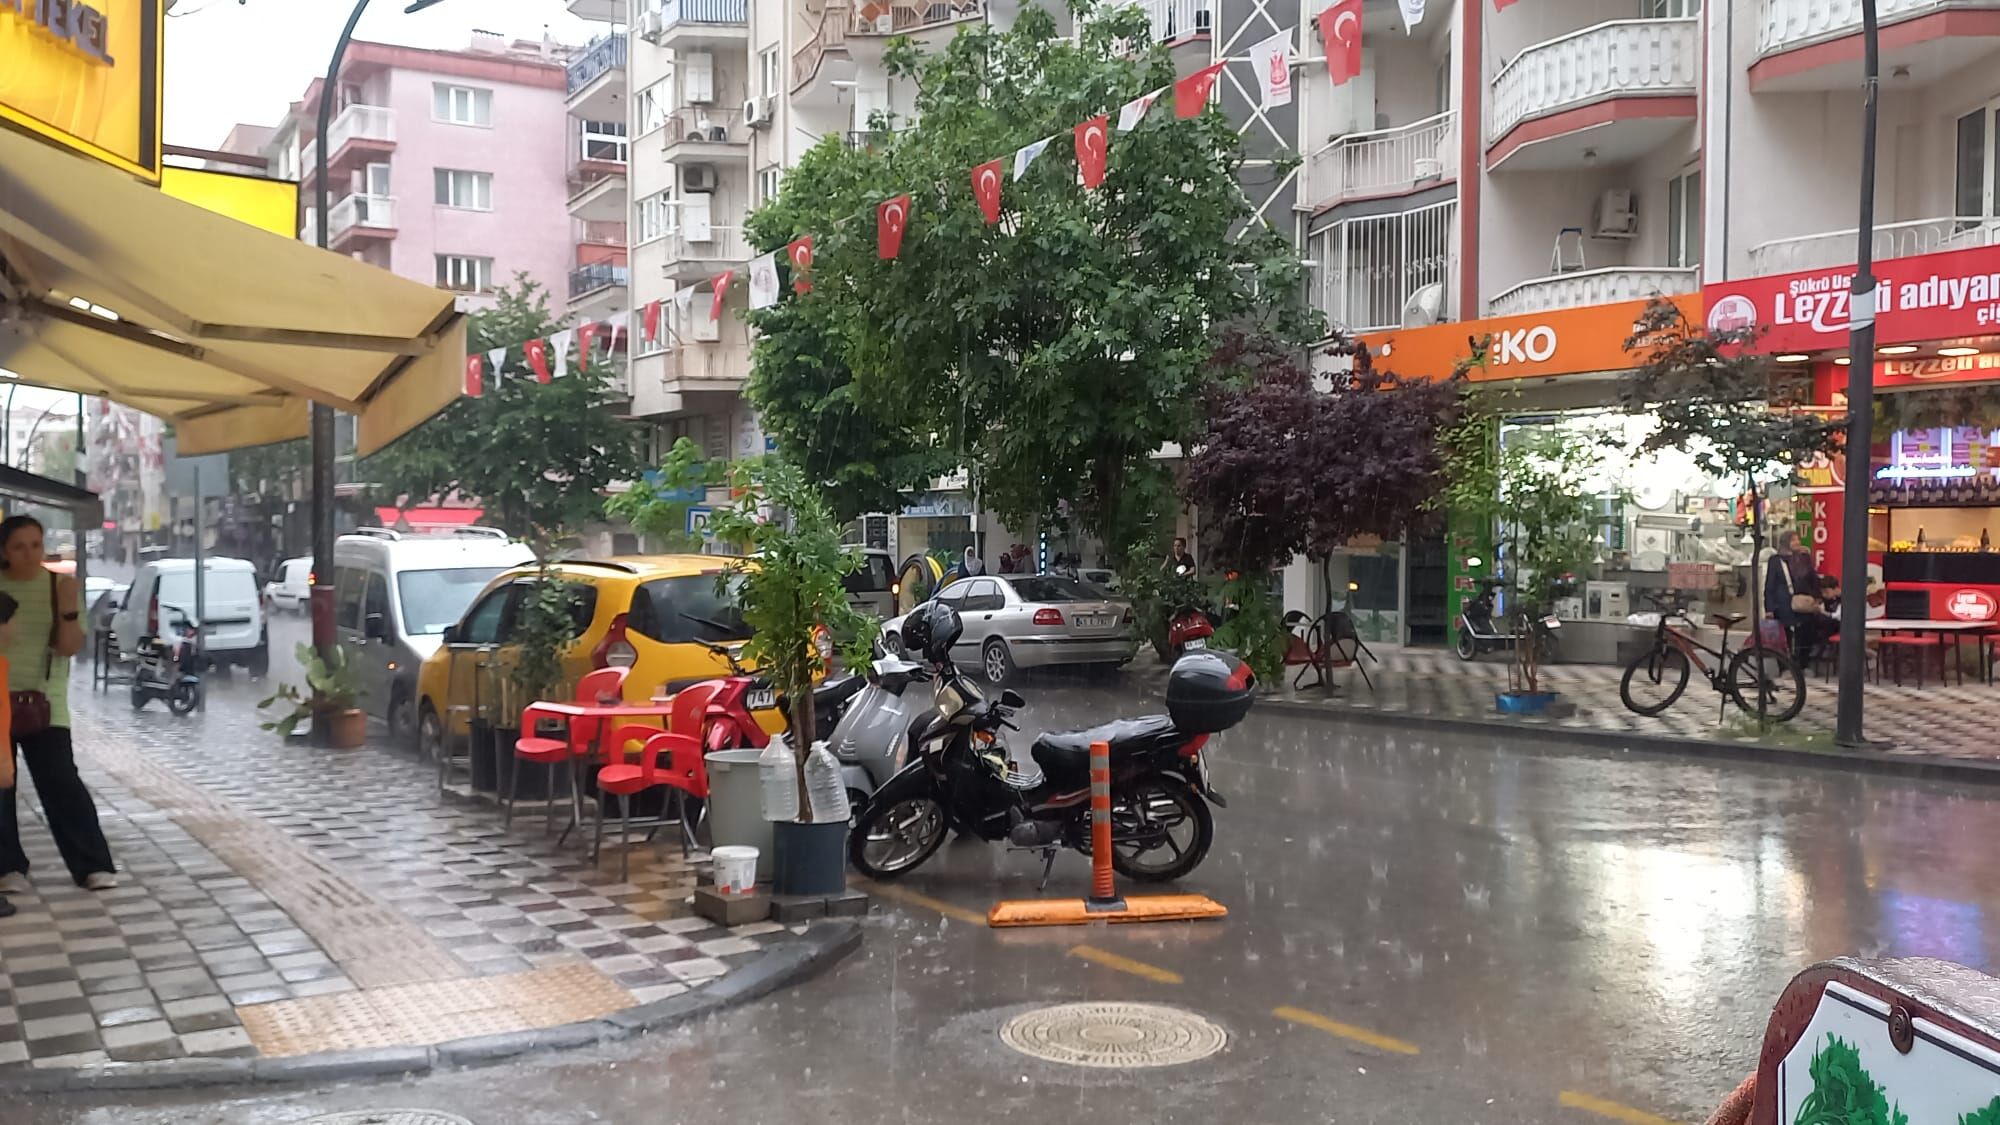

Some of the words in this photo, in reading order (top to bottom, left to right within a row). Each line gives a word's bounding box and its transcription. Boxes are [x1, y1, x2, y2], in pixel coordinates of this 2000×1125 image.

[1775, 279, 1892, 333] Lezzti
[1814, 501, 1828, 578] KÖF
[750, 690, 771, 705] 747
